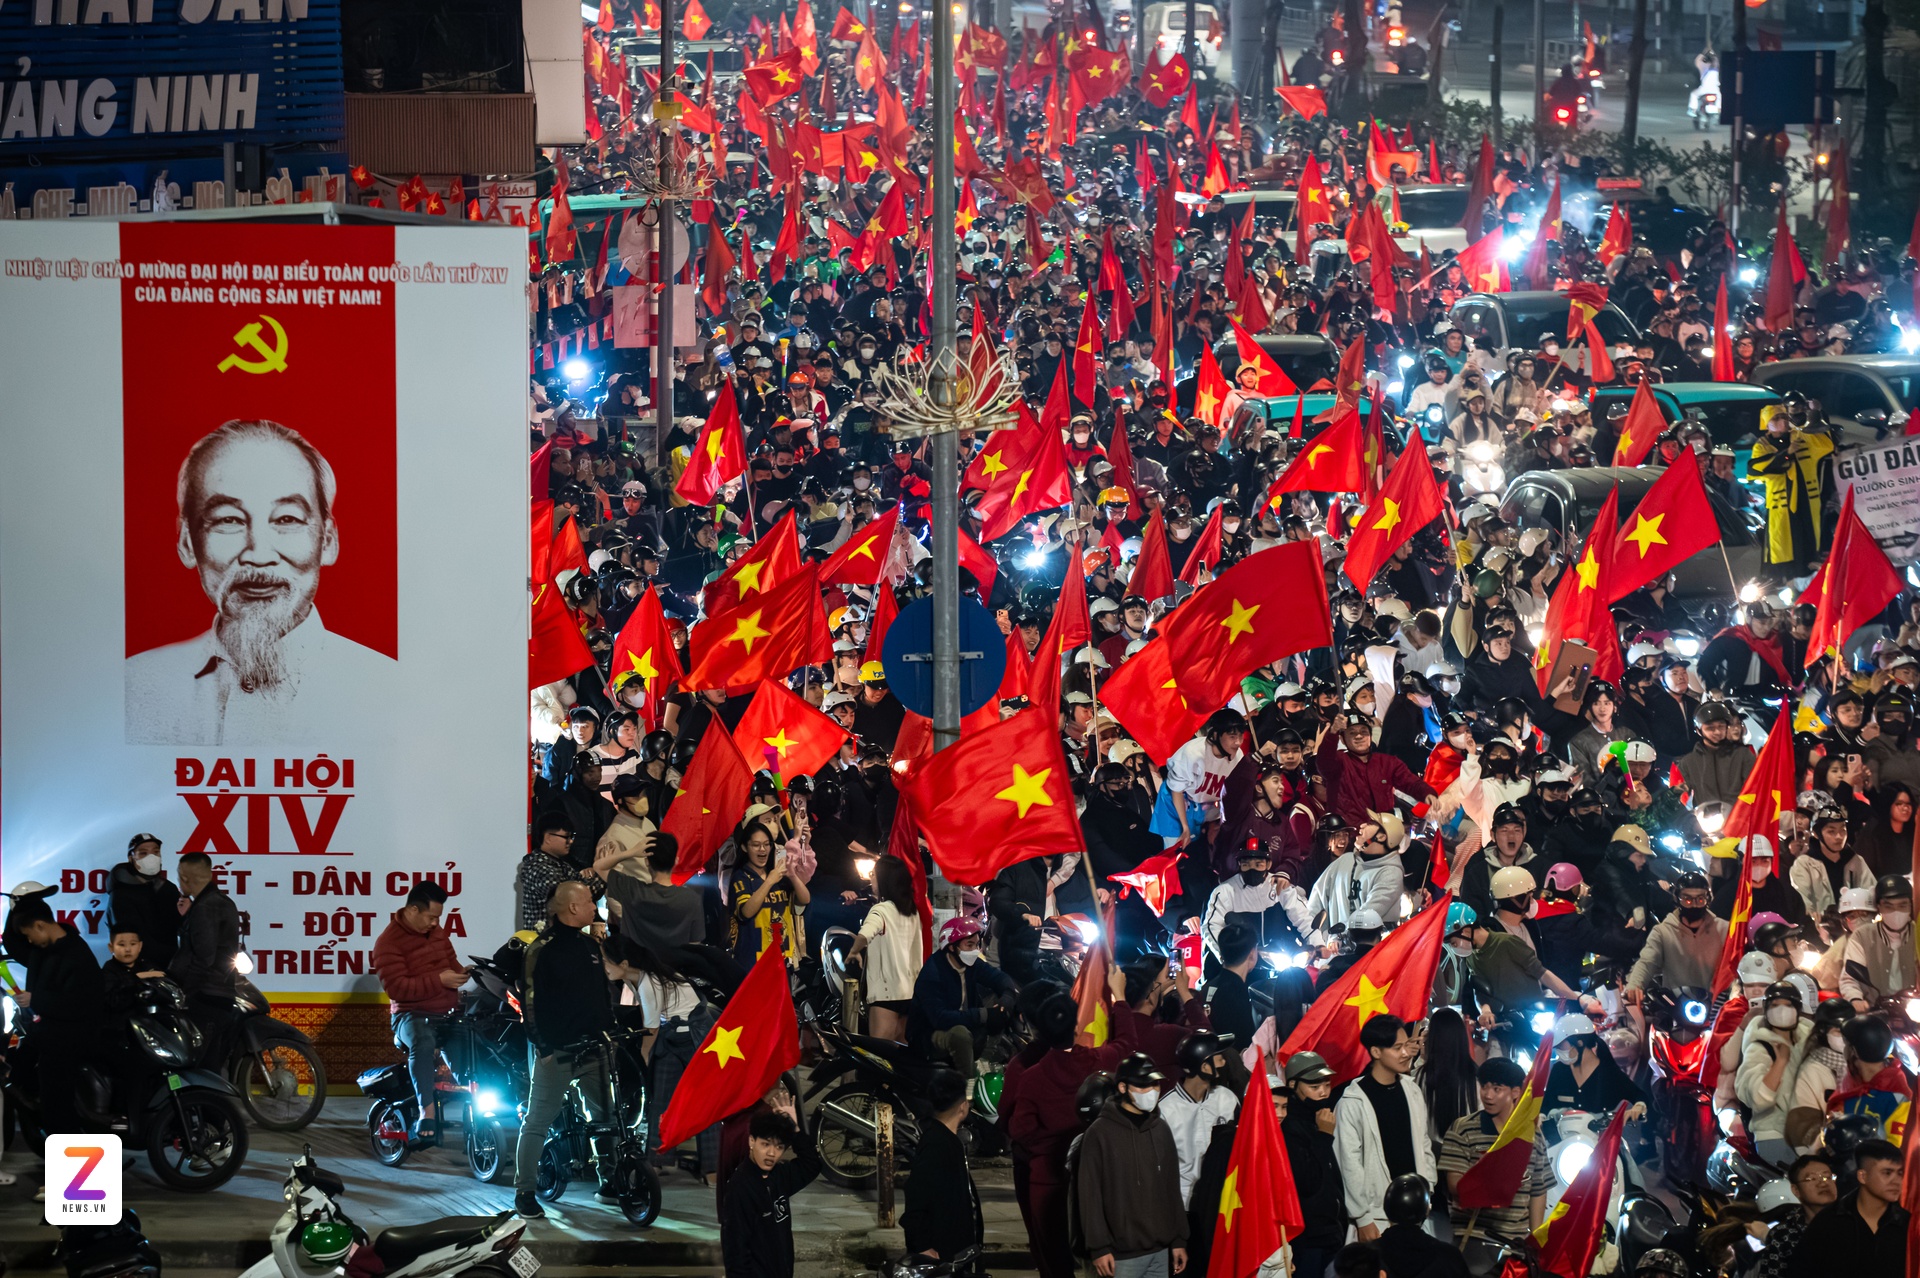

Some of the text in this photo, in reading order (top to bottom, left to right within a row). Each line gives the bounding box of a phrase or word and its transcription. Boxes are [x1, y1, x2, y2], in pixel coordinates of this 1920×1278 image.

[0, 56, 260, 139] ẢNG NINH
[5, 257, 509, 284] NHIỆT LIỆT CHÀO MỪNG ĐẠI HỘI ĐẠI BIỂU TOÀN QUỐC LẦN THỨ XIV
[135, 281, 382, 308] CỦA ĐẢNG CỘNG SẢN VIỆT NAM!
[174, 753, 355, 794] ĐẠI HỘI
[176, 793, 355, 856] XIV
[212, 861, 252, 895] ẾT
[292, 865, 371, 896] DÂN
[57, 899, 106, 935] KỶ
[303, 906, 377, 942] ĐỘT
